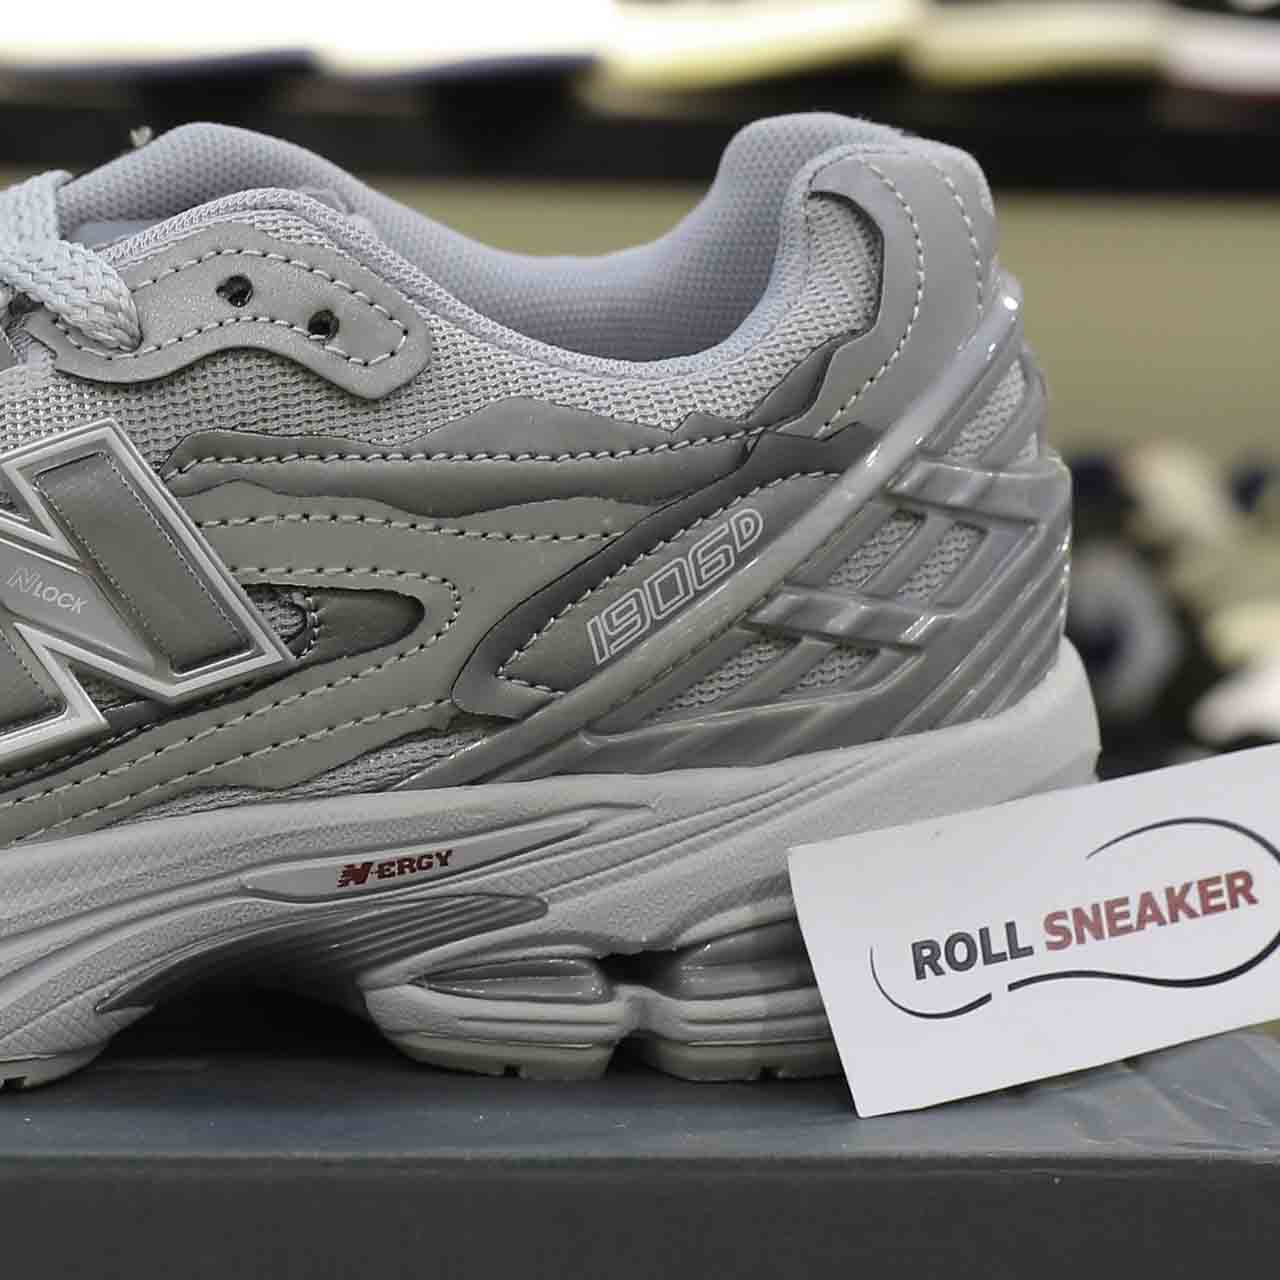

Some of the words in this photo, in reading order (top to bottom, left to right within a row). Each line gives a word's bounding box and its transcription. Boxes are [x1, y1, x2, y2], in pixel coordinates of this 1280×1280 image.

[586, 507, 764, 665] 1906D
[911, 920, 1035, 981] ROLL
[1043, 869, 1259, 951] SNEAKER
